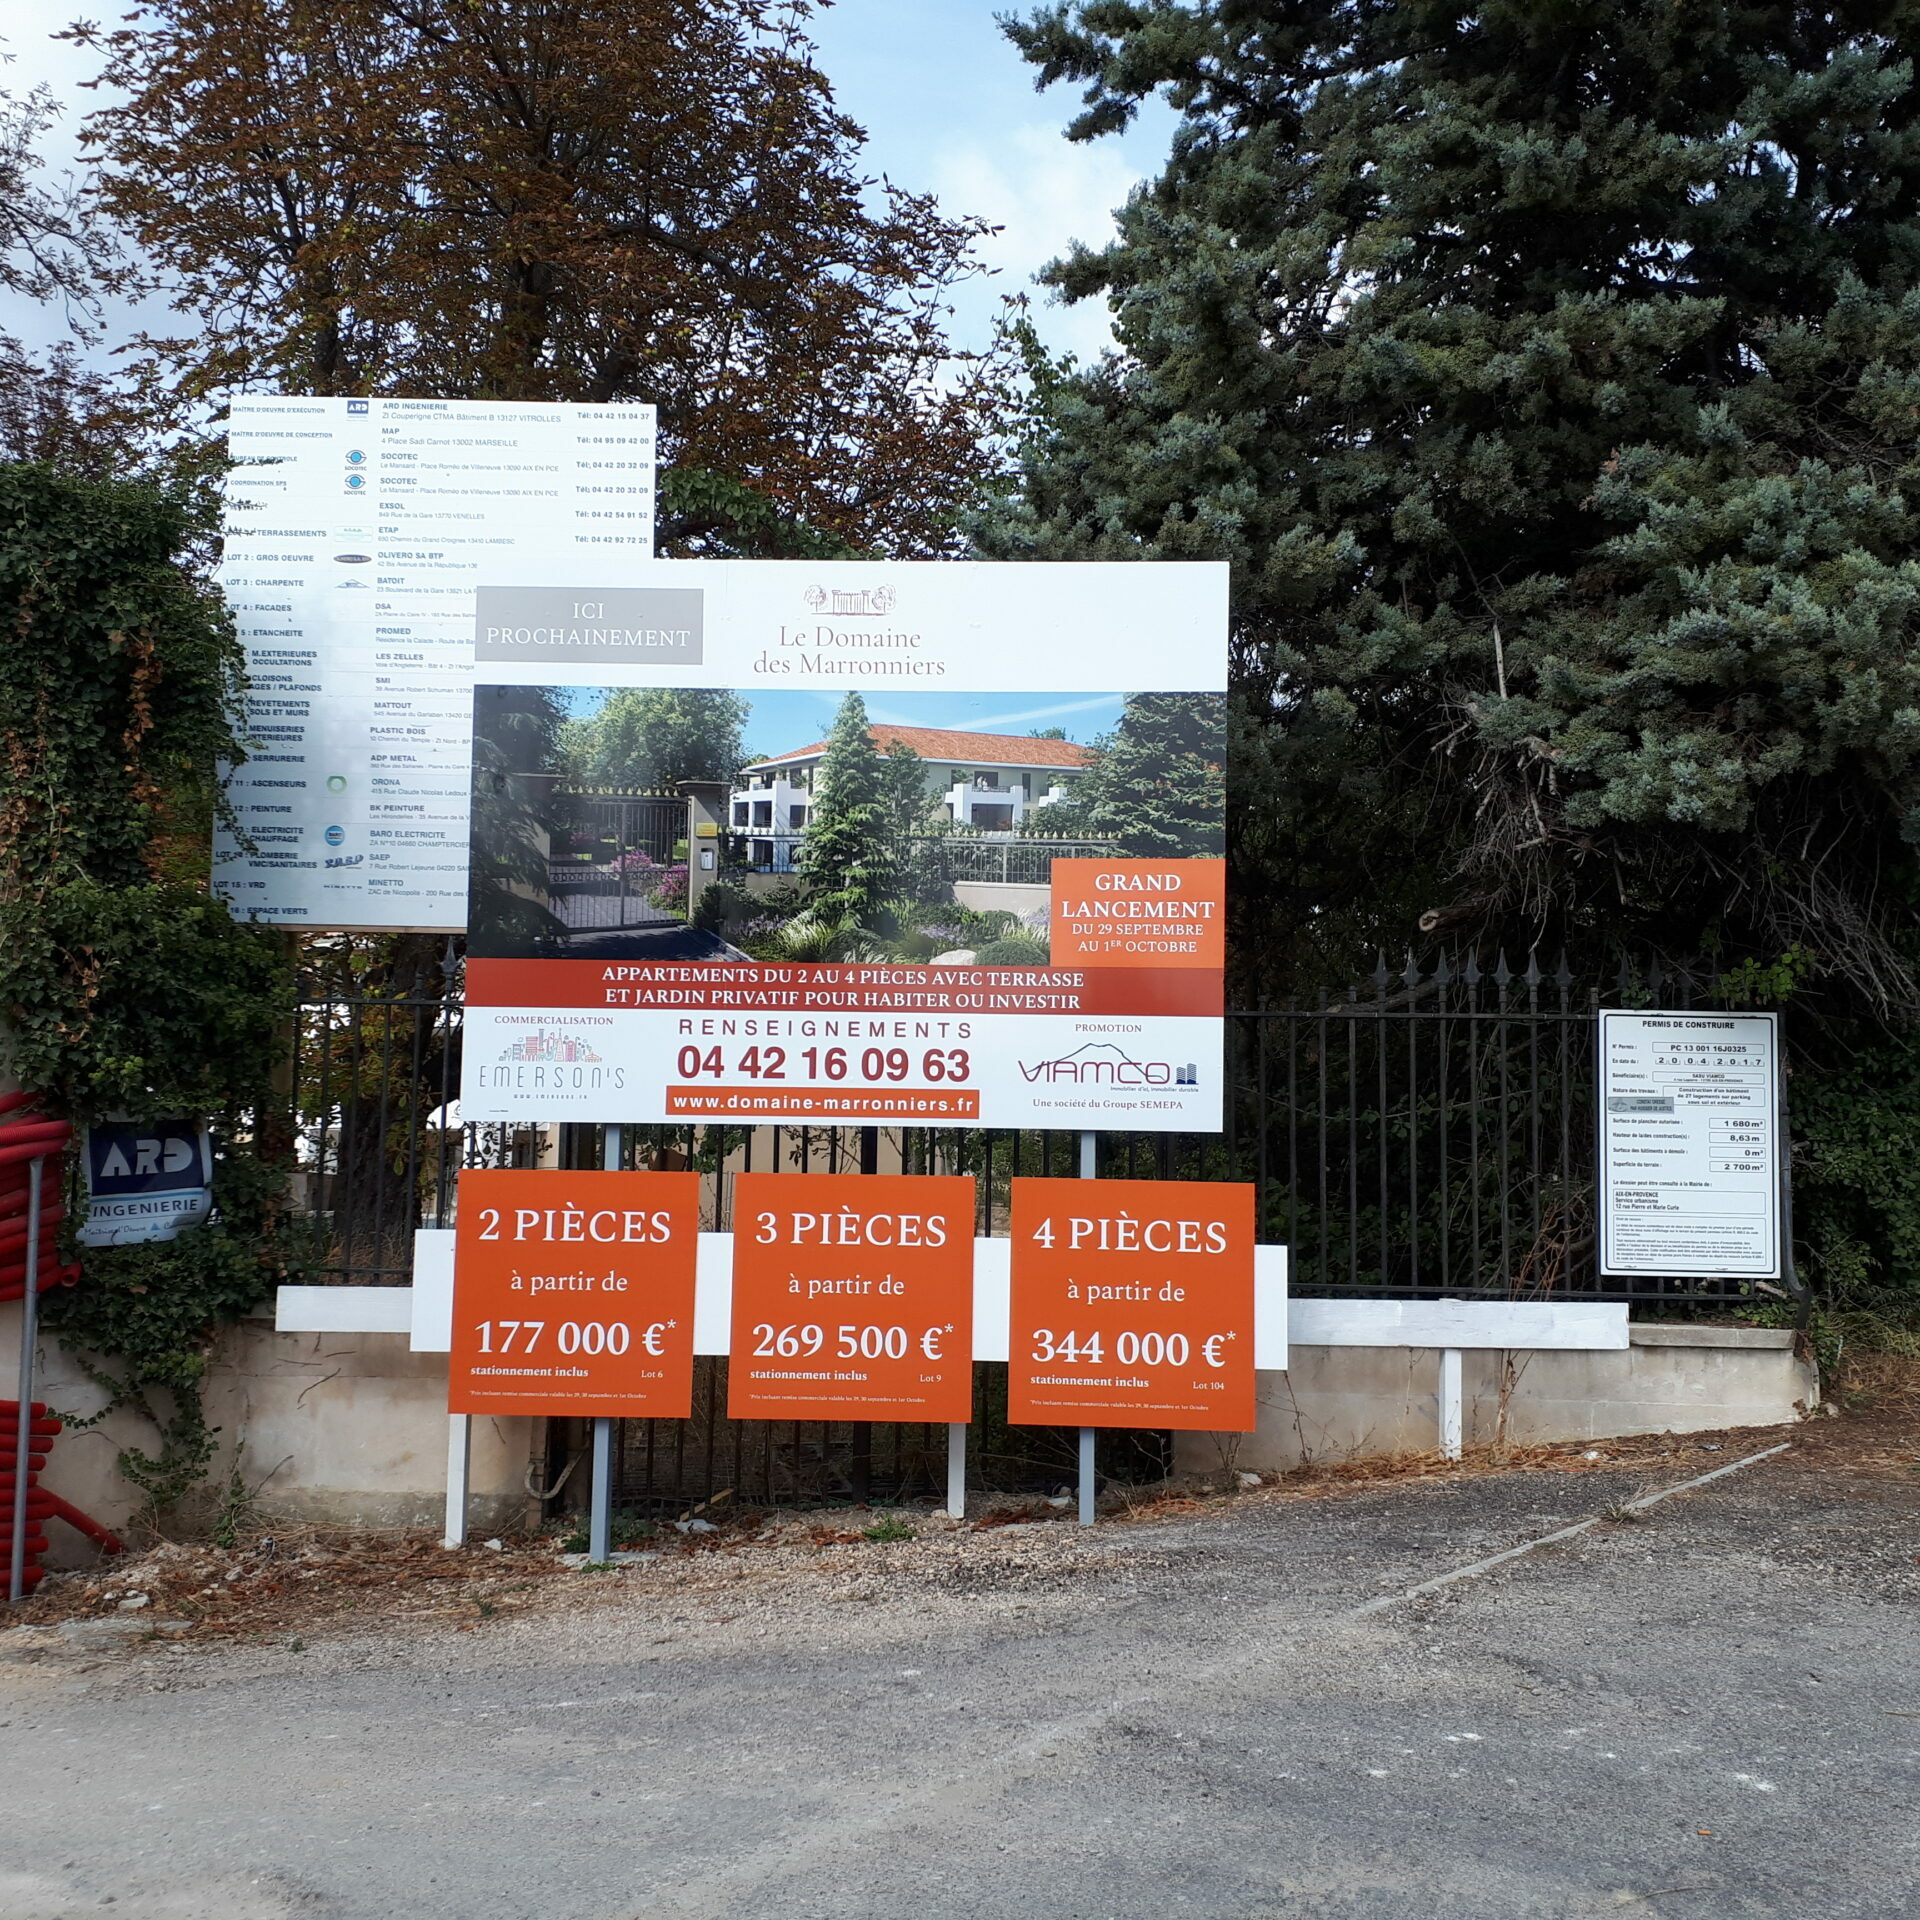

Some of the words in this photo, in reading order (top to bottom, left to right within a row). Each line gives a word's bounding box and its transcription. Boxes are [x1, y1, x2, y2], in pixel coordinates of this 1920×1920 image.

[381, 453, 418, 461] SOCOTEC
[378, 552, 412, 560] OLIVERO
[574, 603, 604, 619] ICI
[487, 628, 690, 646] PROCHAINEMENT
[781, 626, 806, 646] Le
[817, 627, 920, 648] Domaine
[754, 651, 790, 673] des
[800, 654, 944, 675] Marronniers
[1096, 874, 1180, 890] GRAND
[1064, 901, 1215, 918] LANCEMENT
[1072, 924, 1093, 934] DU
[1098, 924, 1112, 934] 29
[1116, 924, 1203, 935] SEPTEMBRE
[1079, 941, 1098, 952] AU
[1126, 941, 1197, 952] OCTOBRE
[602, 967, 758, 982] APPARTEMENTS
[764, 969, 792, 983] DU
[798, 970, 807, 983] 2
[812, 970, 839, 983] AU
[845, 971, 854, 983] 4
[860, 967, 926, 984] PIÈCES
[932, 972, 982, 985] AVEC
[987, 973, 1083, 986] TERRASSE
[606, 989, 630, 1002] ET
[634, 990, 705, 1005] JARDIN
[712, 991, 799, 1004] PRIVATIF
[805, 992, 858, 1005] POUR
[865, 993, 950, 1007] HABITER
[956, 994, 983, 1007] OU
[990, 995, 1080, 1008] INVESTIR
[495, 1016, 613, 1025] COMMERCIALISATION
[680, 1019, 970, 1039] RENSEIGNEMENTS
[1076, 1024, 1141, 1032] PROMOTION
[678, 1046, 724, 1078] 04
[738, 1047, 786, 1079] 42
[802, 1048, 847, 1080] 16
[862, 1048, 908, 1081] 09
[923, 1049, 970, 1082] 63
[1018, 1059, 1172, 1084] VIAMCO
[480, 1066, 624, 1088] EMERSON'S
[674, 1095, 972, 1111] www.domaine-marronniers.fr
[1089, 1099, 1100, 1108] du
[1103, 1100, 1137, 1110] Groupe
[1140, 1101, 1183, 1109] SEMEPA
[100, 1139, 193, 1177] ARD
[94, 1200, 198, 1217] INGENIERIE
[479, 1209, 499, 1240] 2
[514, 1202, 670, 1243] PIÈCES
[756, 1213, 777, 1243] 3
[791, 1206, 946, 1247] PIÈCES
[1033, 1218, 1055, 1248] 4
[1069, 1211, 1226, 1253] PIÈCES
[511, 1270, 523, 1289] à
[530, 1271, 595, 1295] partir
[602, 1270, 627, 1291] de
[789, 1273, 800, 1293] à
[808, 1275, 872, 1299] partir
[879, 1274, 904, 1295] de
[1068, 1279, 1079, 1298] à
[1088, 1281, 1152, 1304] partir
[1159, 1281, 1184, 1301] de
[476, 1321, 544, 1353] 177
[558, 1322, 629, 1355] 000
[753, 1324, 823, 1357] 269
[838, 1326, 907, 1359] 500
[1032, 1330, 1104, 1363] 344
[1117, 1332, 1189, 1366] 000
[471, 1365, 552, 1376] stationnement
[555, 1366, 588, 1376] inclus
[751, 1369, 830, 1380] stationnement
[835, 1370, 867, 1380] inclus
[1031, 1375, 1112, 1386] stationnement
[1116, 1377, 1149, 1387] inclus
